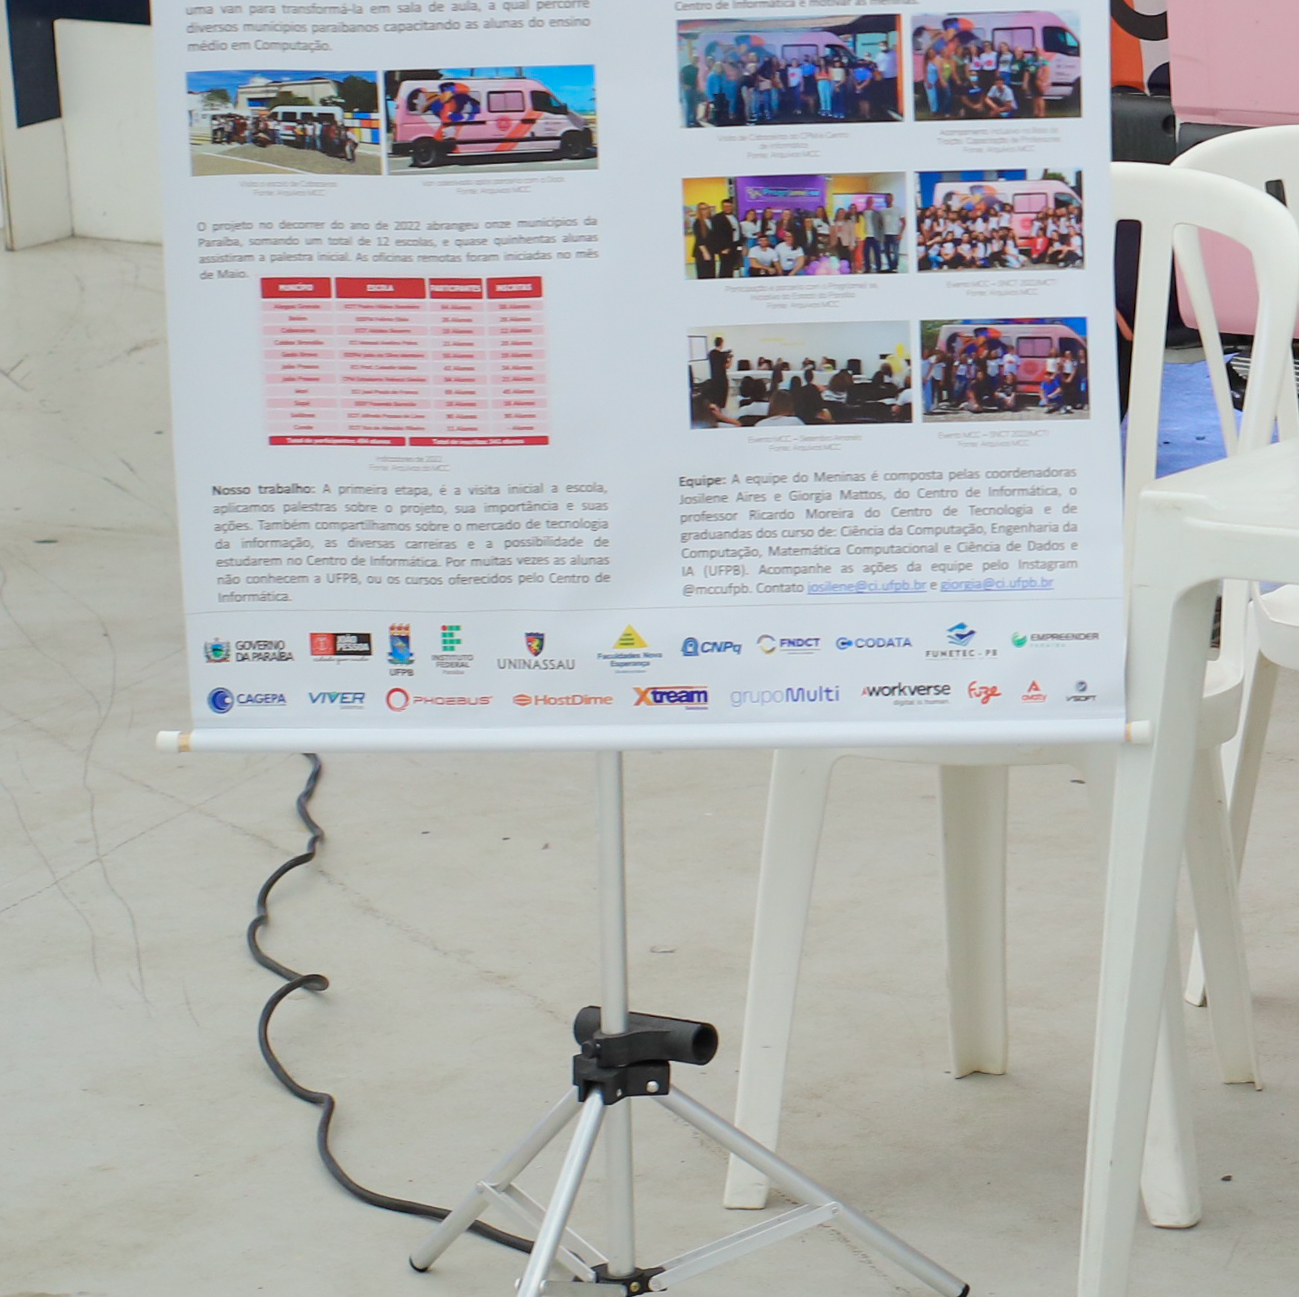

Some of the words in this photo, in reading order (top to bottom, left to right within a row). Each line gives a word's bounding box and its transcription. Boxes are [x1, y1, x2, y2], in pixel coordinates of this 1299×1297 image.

[756, 582, 804, 594] Contato
[930, 582, 938, 590] e
[779, 638, 821, 647] FNDCT
[855, 637, 913, 648] CODATA
[1030, 632, 1100, 641] EMPREENDER
[235, 640, 286, 652] GOVERNO
[700, 640, 743, 655] CNPq
[235, 651, 250, 662] DA
[251, 649, 294, 662] PARAÍBA
[497, 659, 576, 670] UNINASSAU
[388, 668, 414, 676] UFPB
[236, 693, 287, 704] CAGEPA
[308, 692, 366, 704] VIVER
[413, 694, 493, 706] PHOEBUS
[534, 694, 614, 706] HostDime
